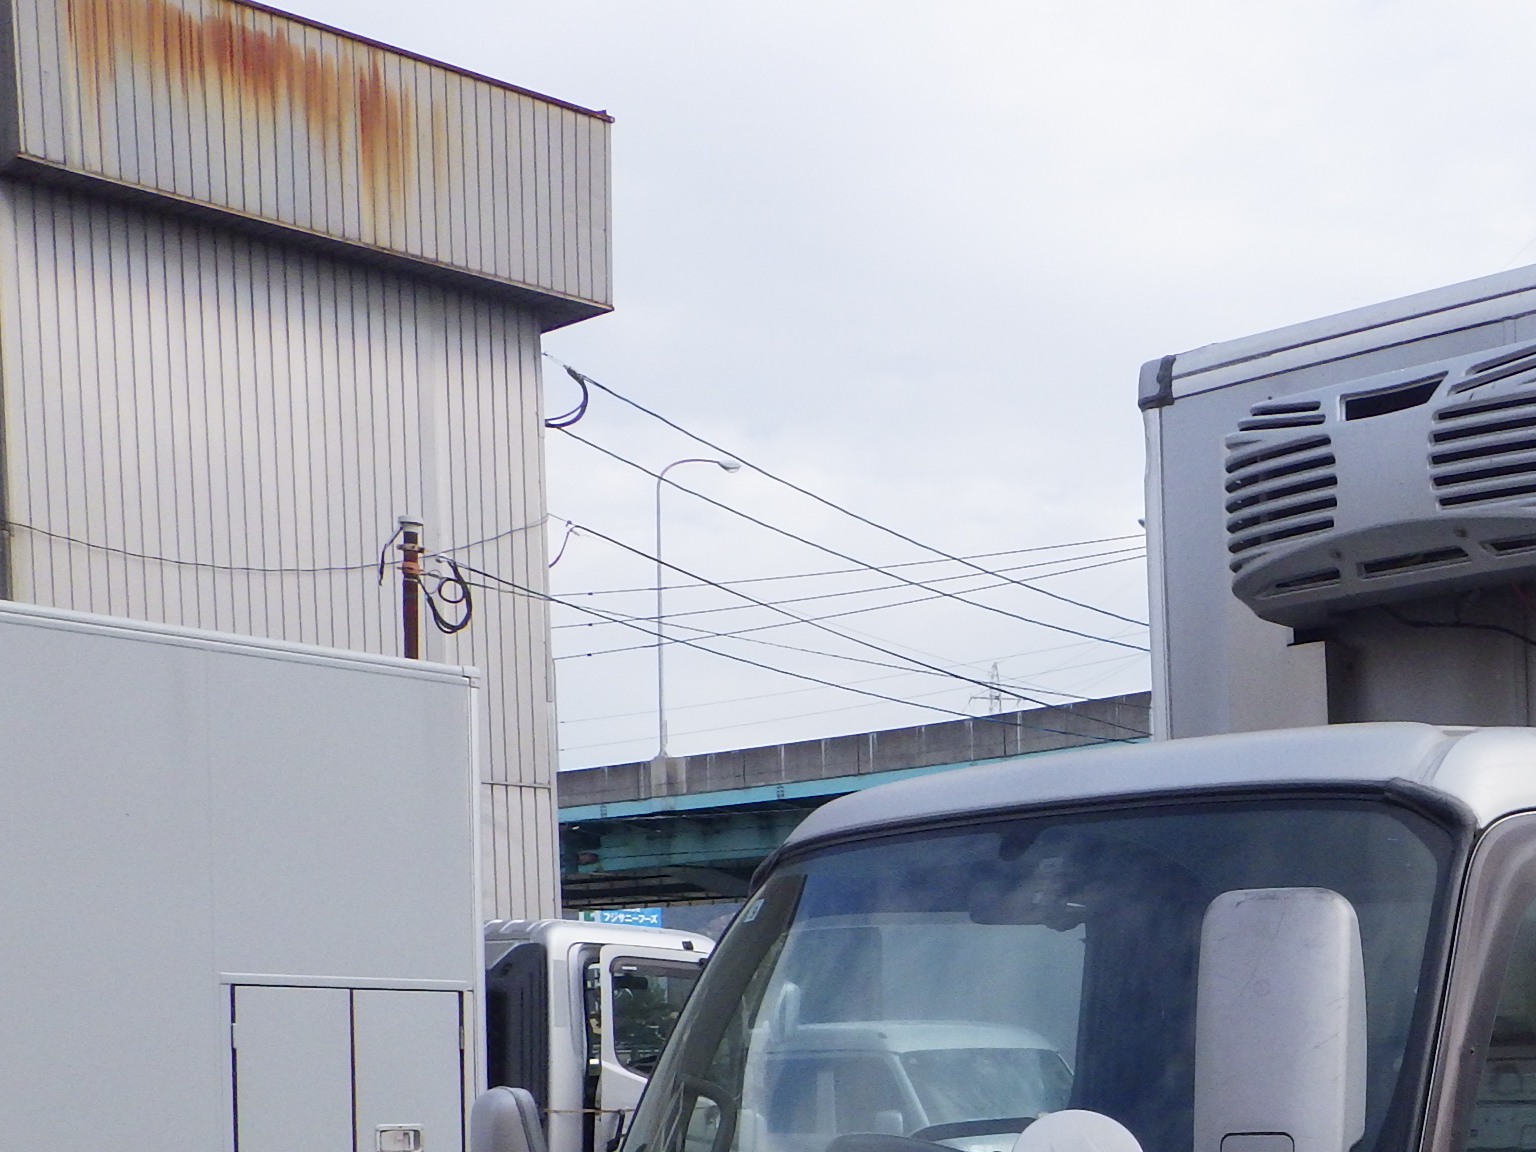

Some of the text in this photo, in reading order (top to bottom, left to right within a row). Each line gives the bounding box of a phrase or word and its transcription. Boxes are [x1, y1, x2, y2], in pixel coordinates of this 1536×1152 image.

[603, 912, 658, 924] フジサニーフーズ
